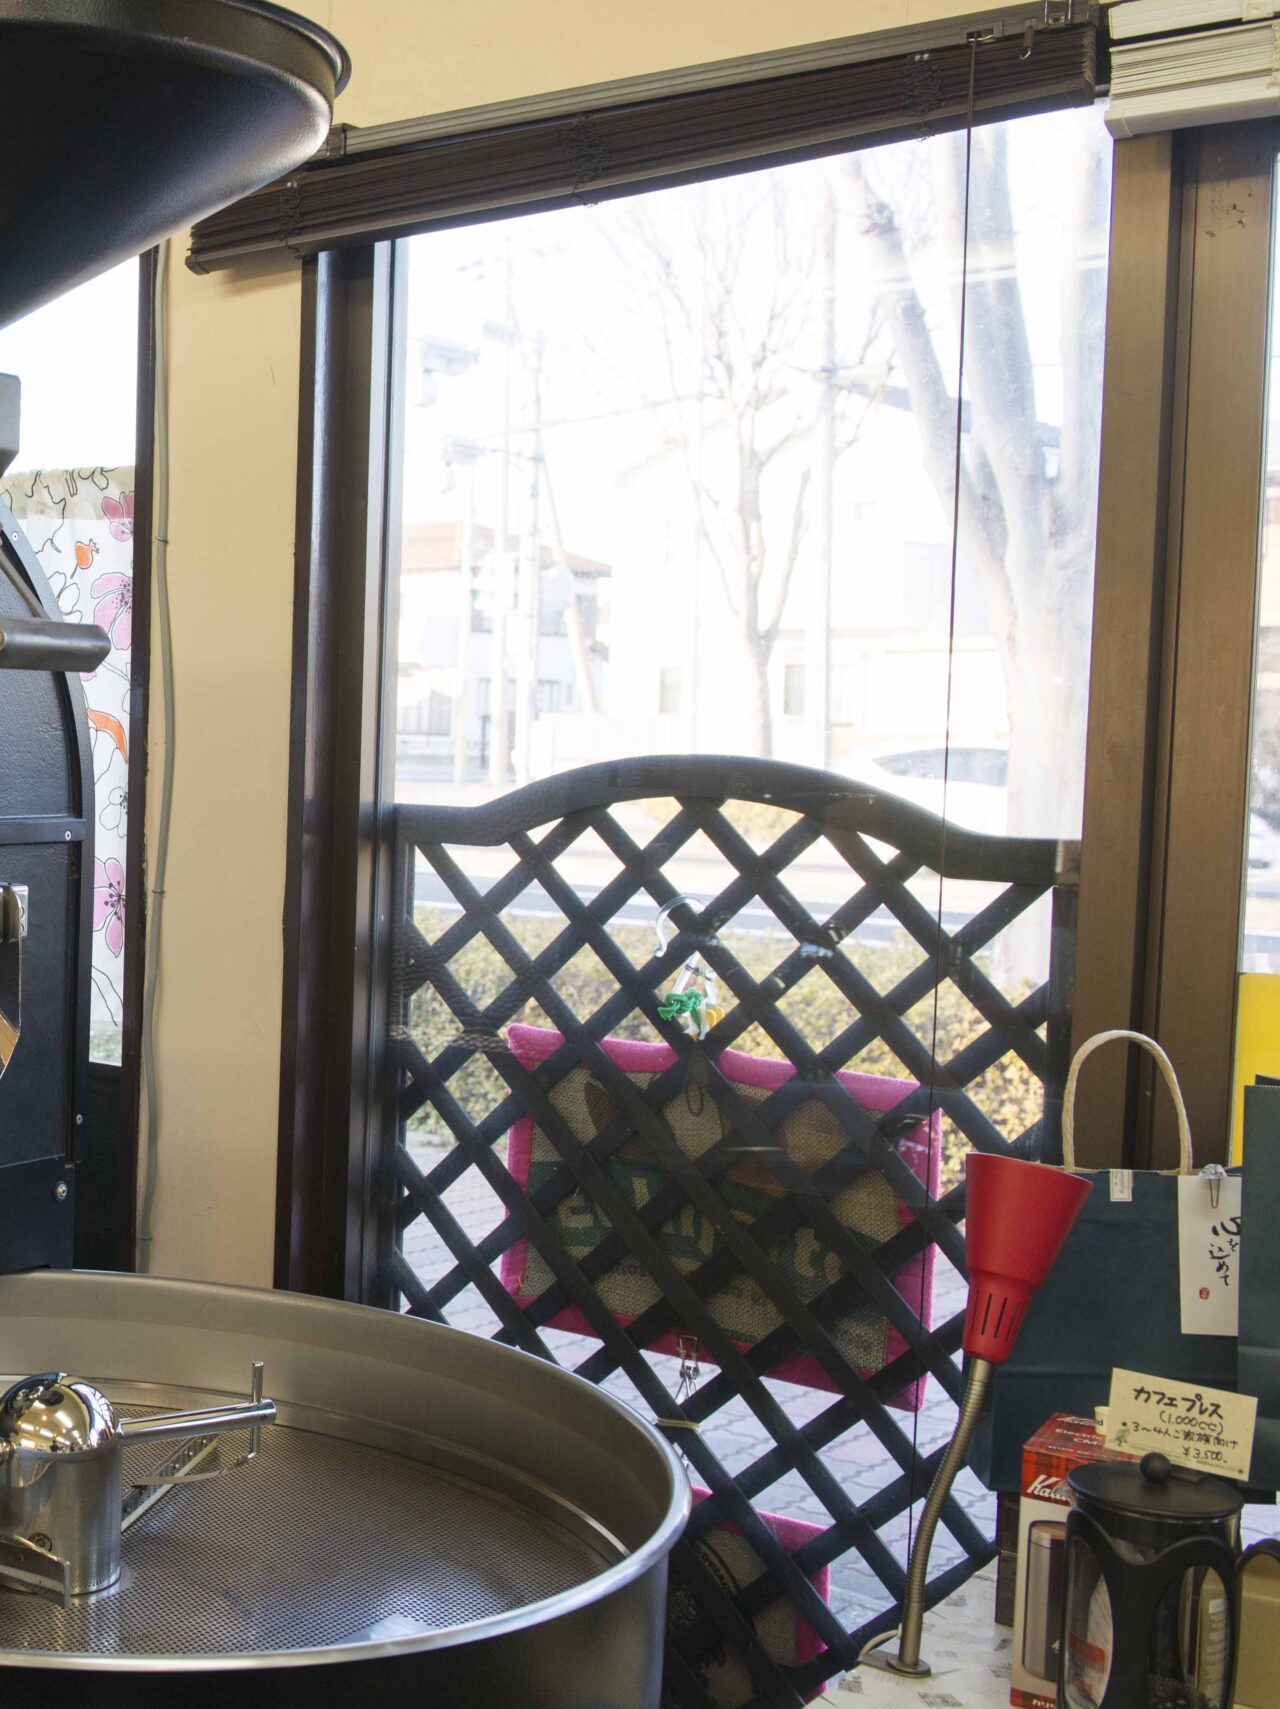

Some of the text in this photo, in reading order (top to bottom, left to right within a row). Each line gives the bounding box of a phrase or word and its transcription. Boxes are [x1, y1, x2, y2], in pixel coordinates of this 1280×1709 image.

[1133, 1386, 1224, 1419] カフェプレス
